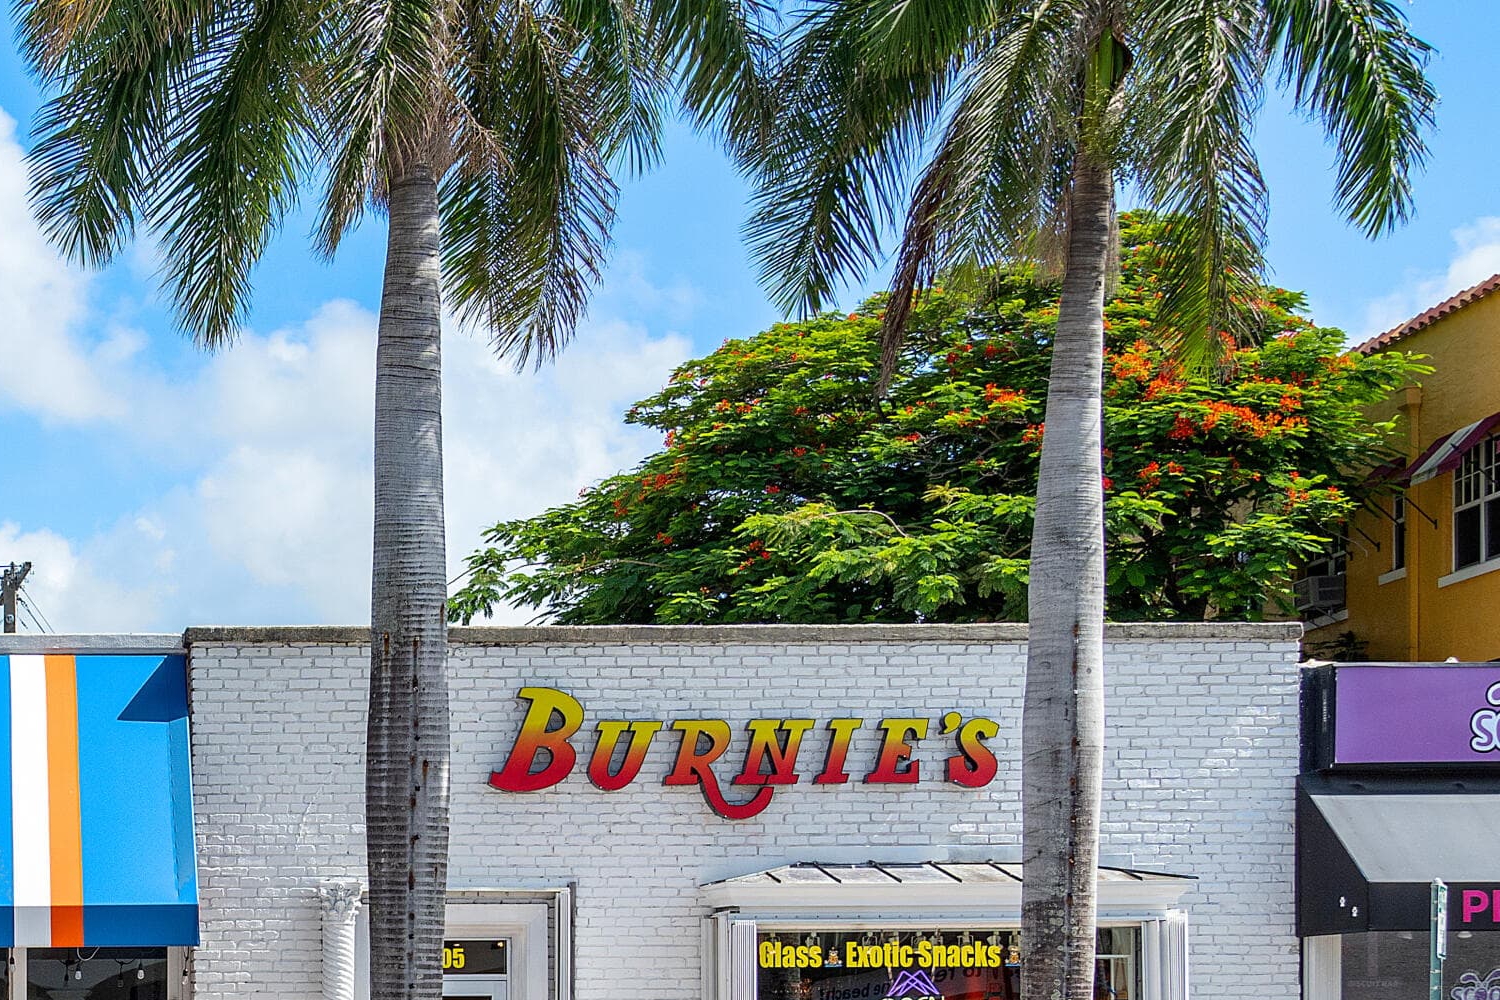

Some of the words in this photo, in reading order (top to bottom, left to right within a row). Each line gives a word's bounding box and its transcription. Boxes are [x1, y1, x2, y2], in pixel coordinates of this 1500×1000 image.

[1469, 708, 1500, 753] S
[487, 686, 1000, 820] BURNIE'S
[1462, 890, 1500, 923] P
[443, 948, 465, 969] 05
[759, 941, 822, 968] Glass
[846, 940, 914, 968] Exotic
[918, 940, 1002, 968] Snacks
